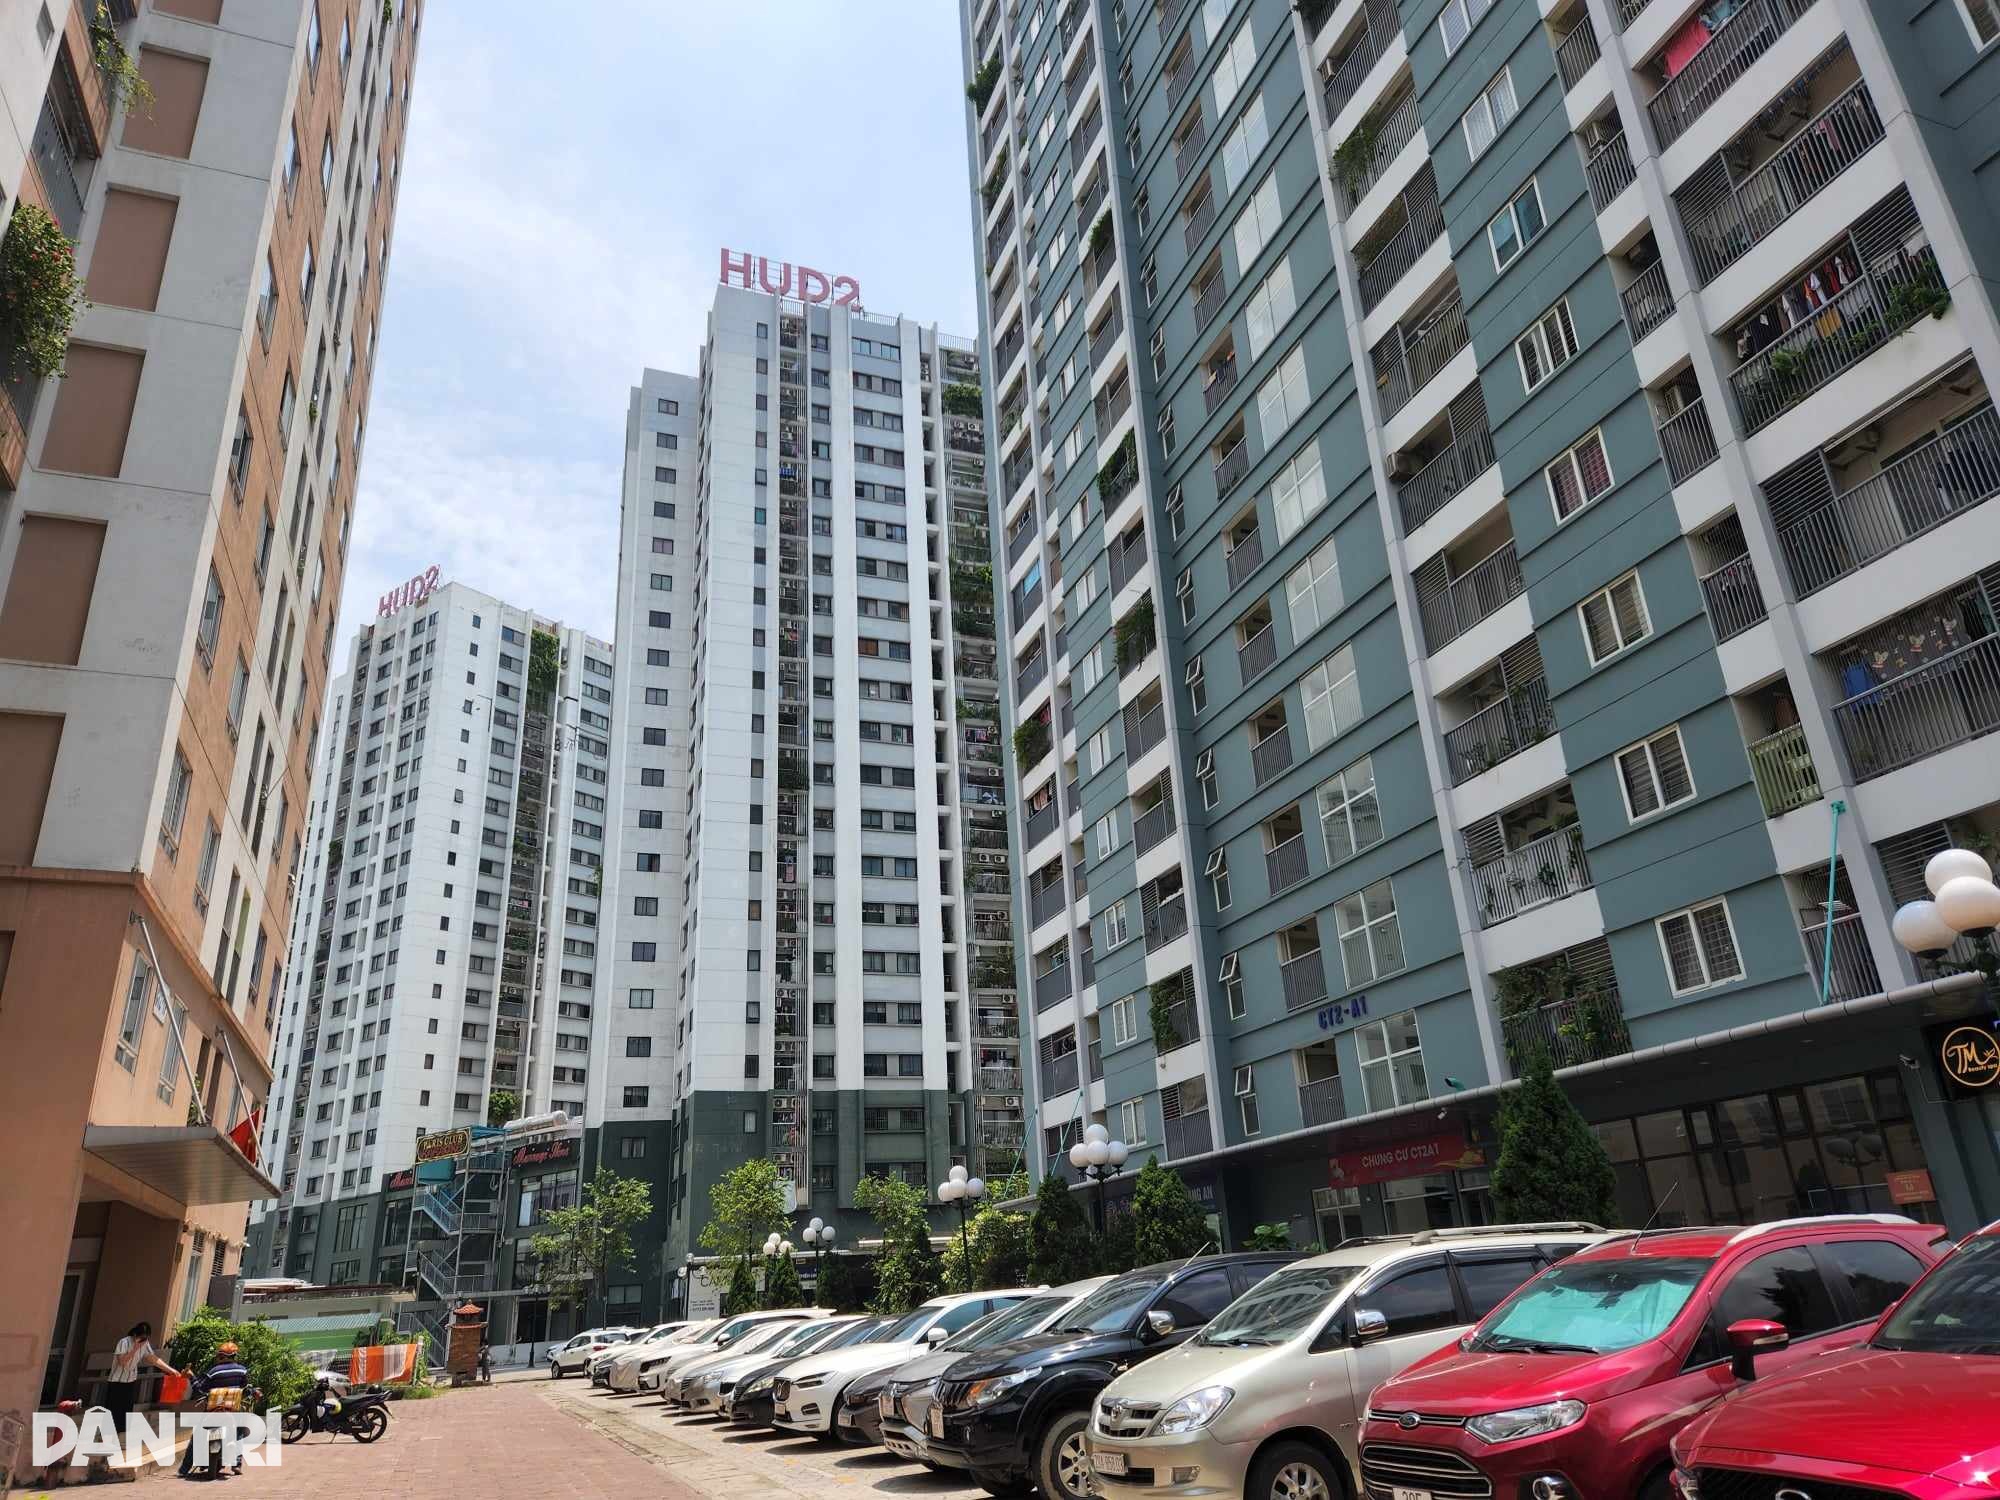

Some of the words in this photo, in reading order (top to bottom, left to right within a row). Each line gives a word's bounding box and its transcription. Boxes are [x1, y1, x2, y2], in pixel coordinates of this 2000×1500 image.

[720, 247, 861, 312] HUD2
[378, 565, 440, 617] HUD2
[1318, 995, 1368, 1029] CT2-A1
[423, 1138, 443, 1150] PARIS
[444, 1134, 463, 1146] CLUB
[1361, 1152, 1393, 1168] CHUNG
[1410, 1143, 1440, 1160] CT2A1
